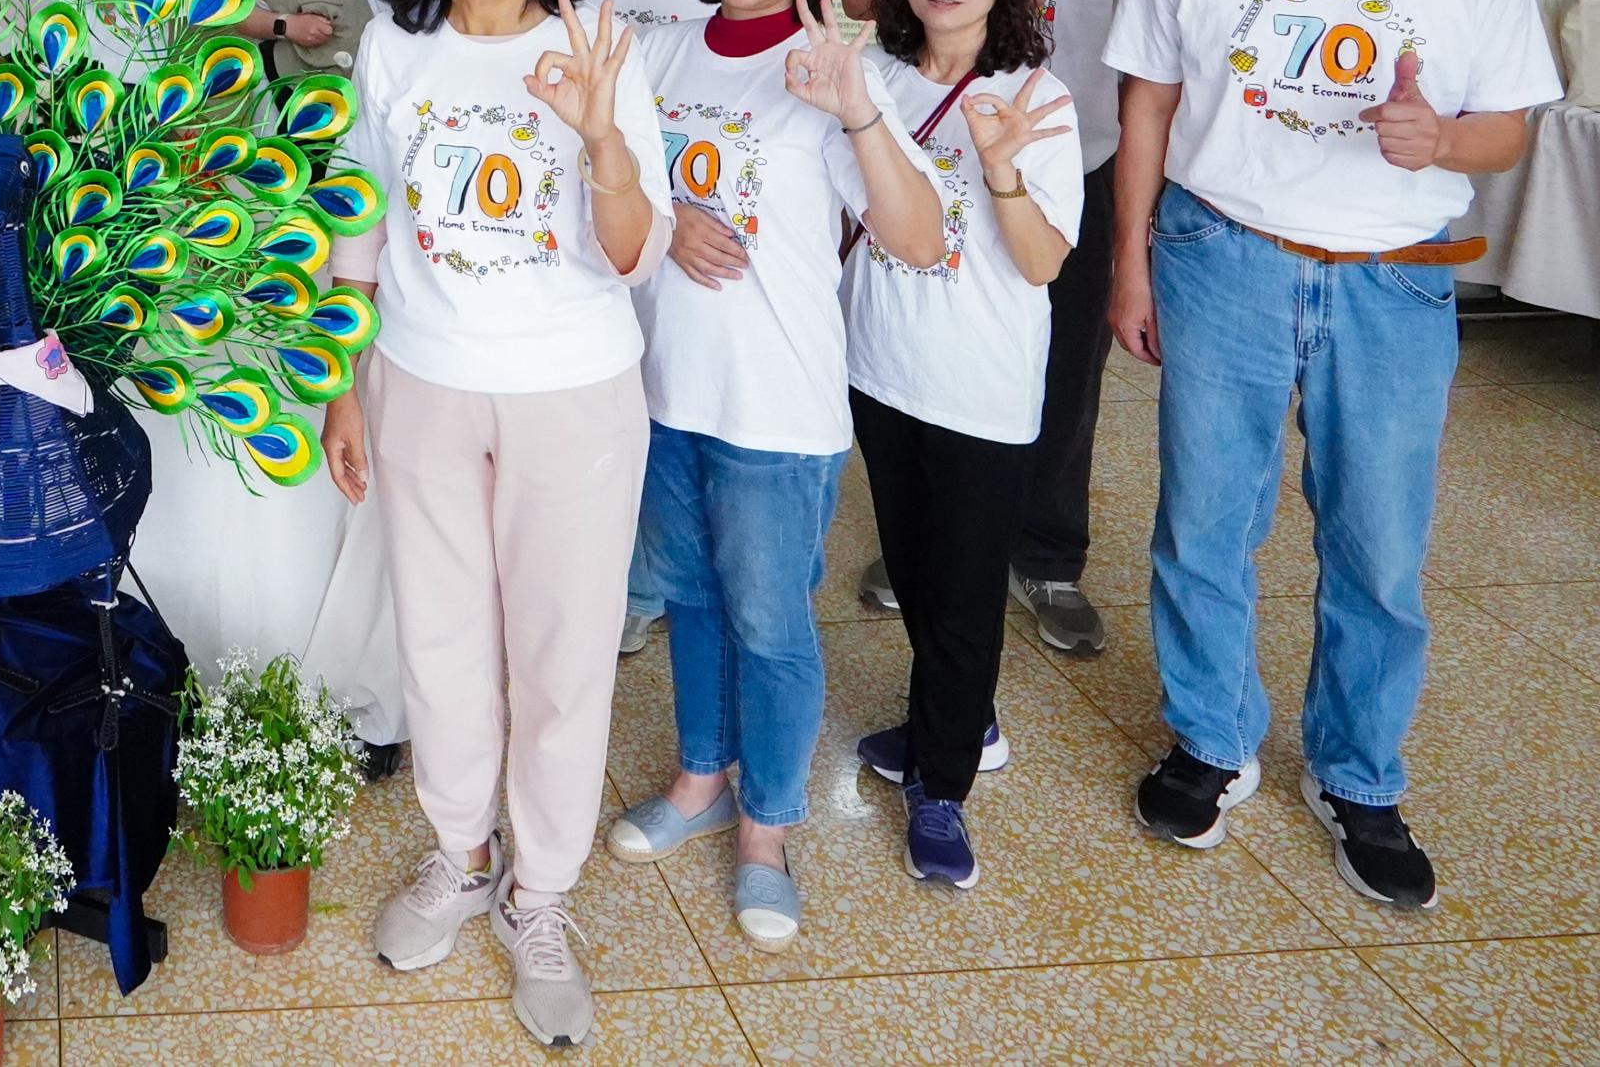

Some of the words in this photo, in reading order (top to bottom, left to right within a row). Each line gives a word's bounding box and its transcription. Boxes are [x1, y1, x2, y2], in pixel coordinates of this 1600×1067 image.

[1273, 78, 1304, 94] Home
[1312, 84, 1376, 102] Economics
[438, 216, 466, 231] Home
[472, 221, 526, 237] Economics
